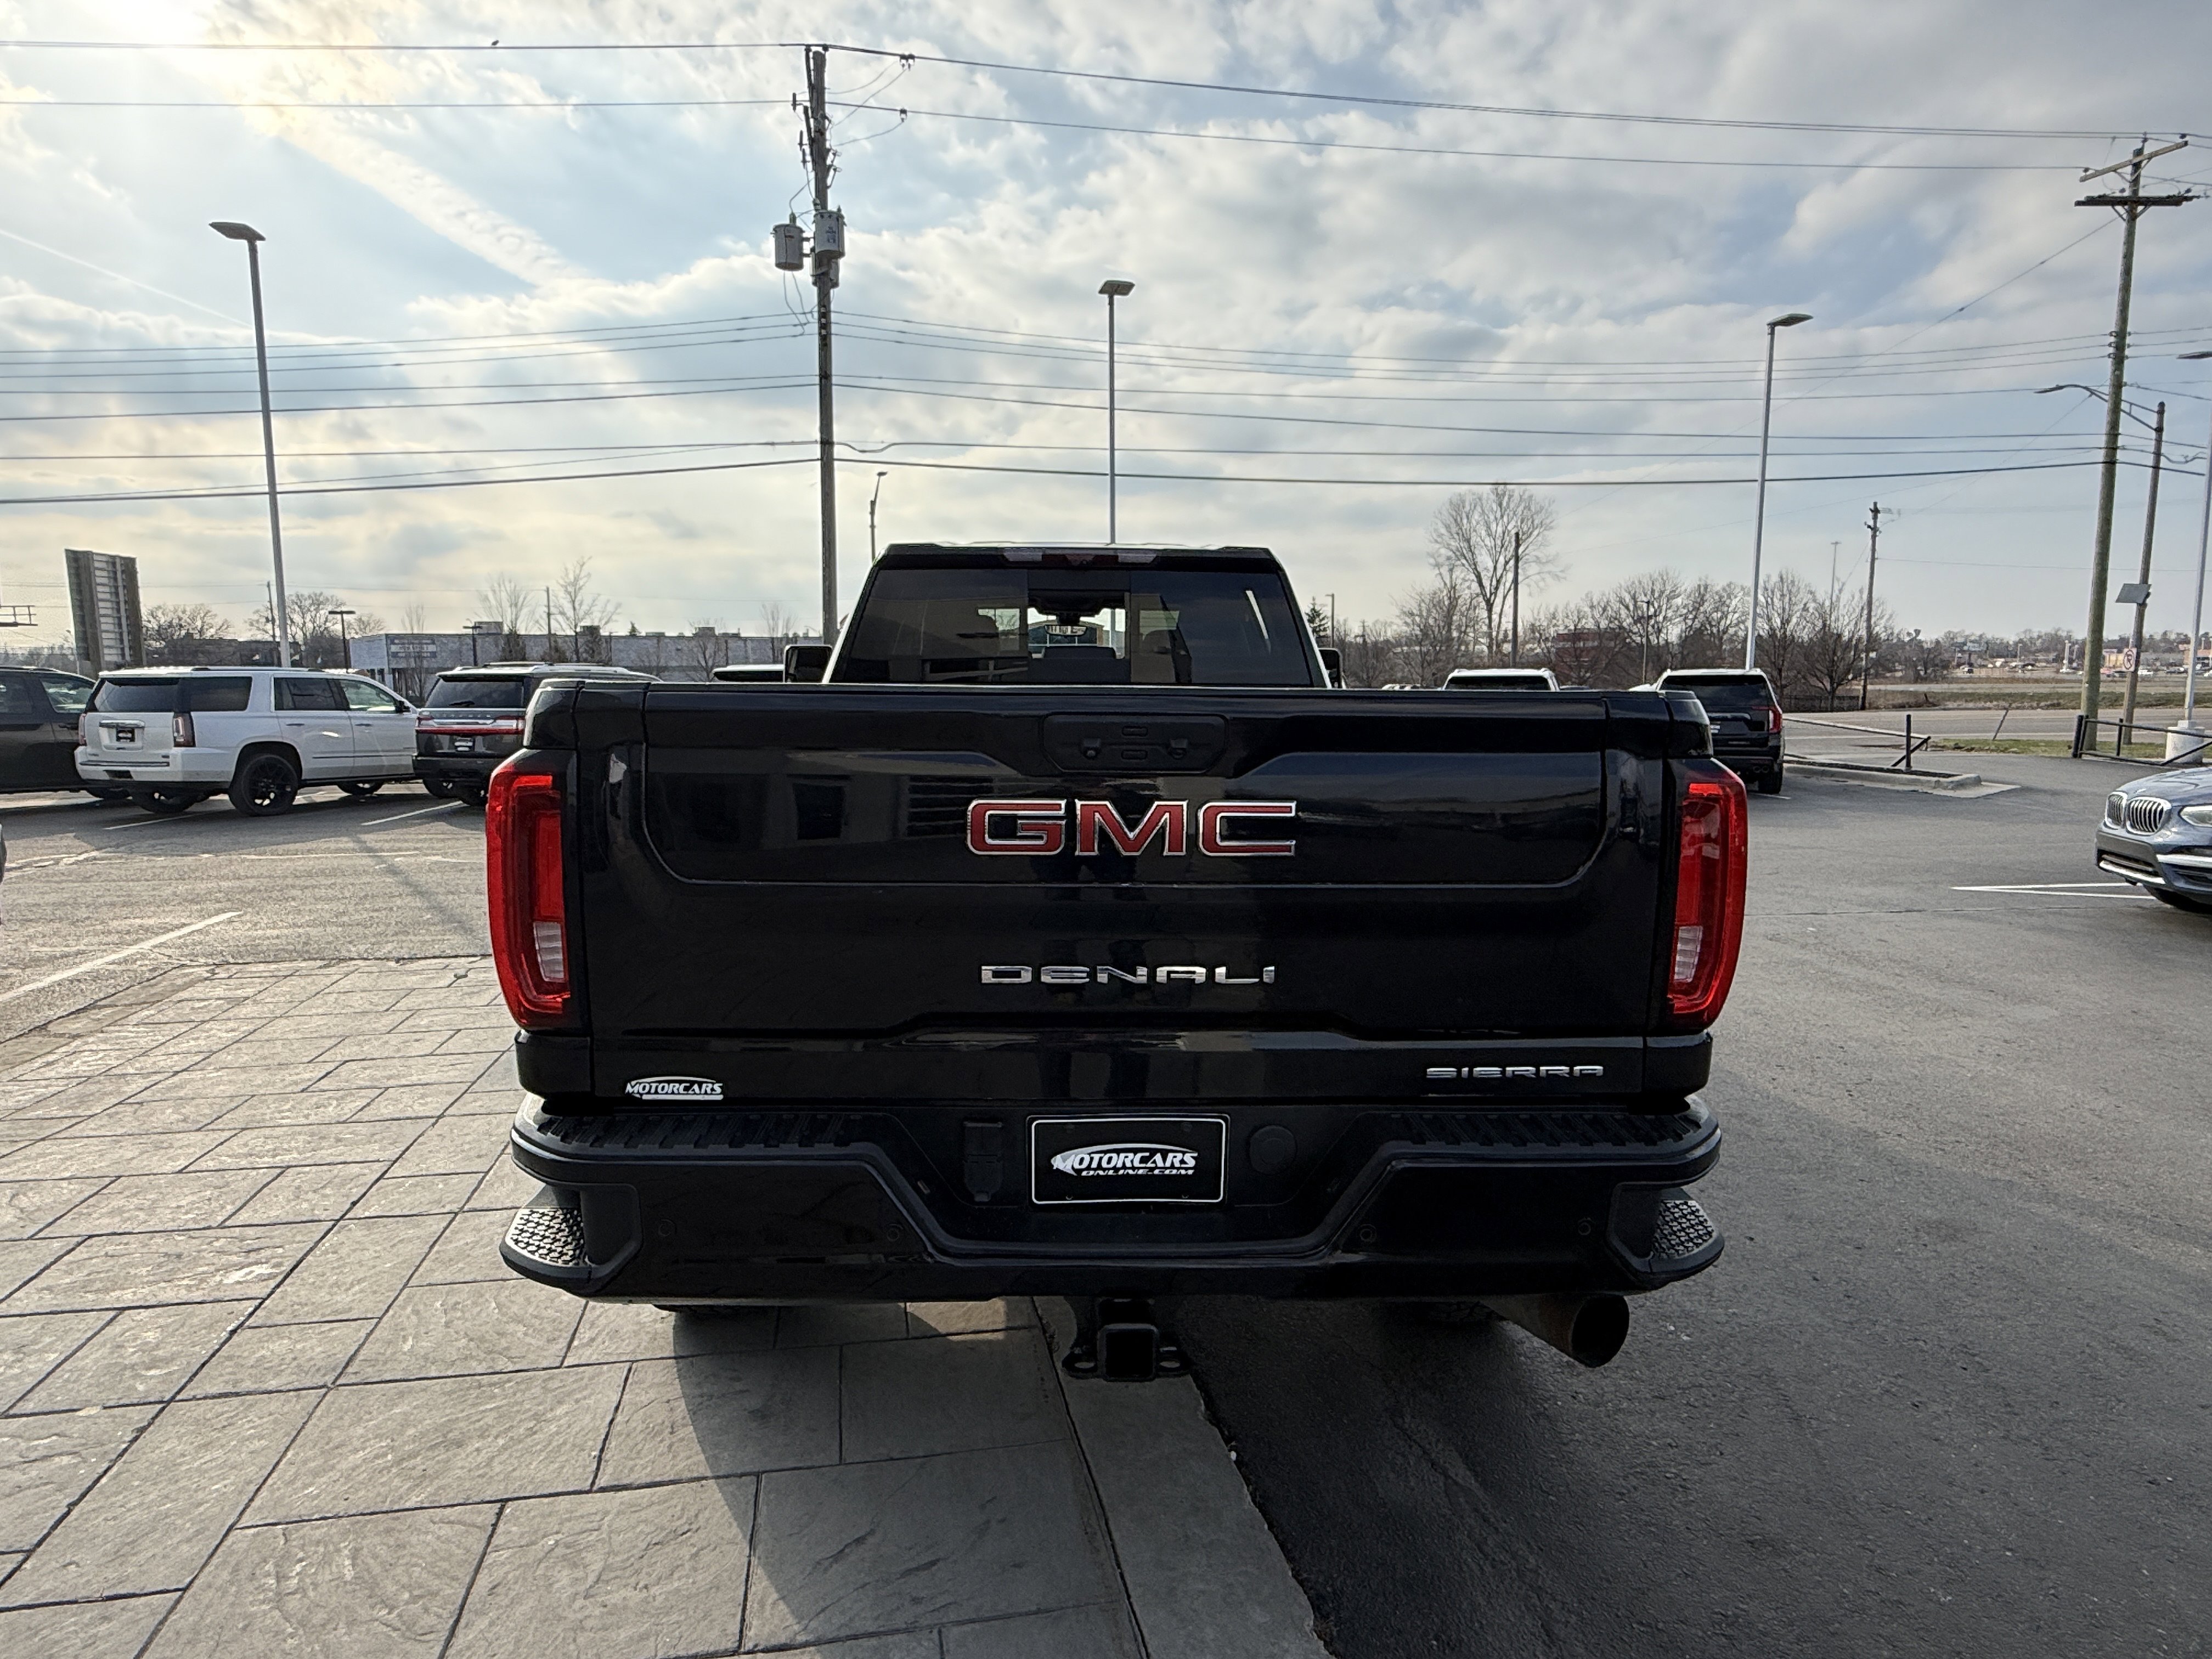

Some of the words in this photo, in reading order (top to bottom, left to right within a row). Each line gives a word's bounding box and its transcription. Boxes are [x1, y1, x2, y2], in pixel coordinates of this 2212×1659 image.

[966, 799, 1297, 856] GMC
[981, 966, 1275, 984] DENALI
[1426, 1066, 1604, 1079] SIERRA
[624, 1082, 723, 1094] MOTORCARS
[1052, 1152, 1198, 1169] MOTORCARS
